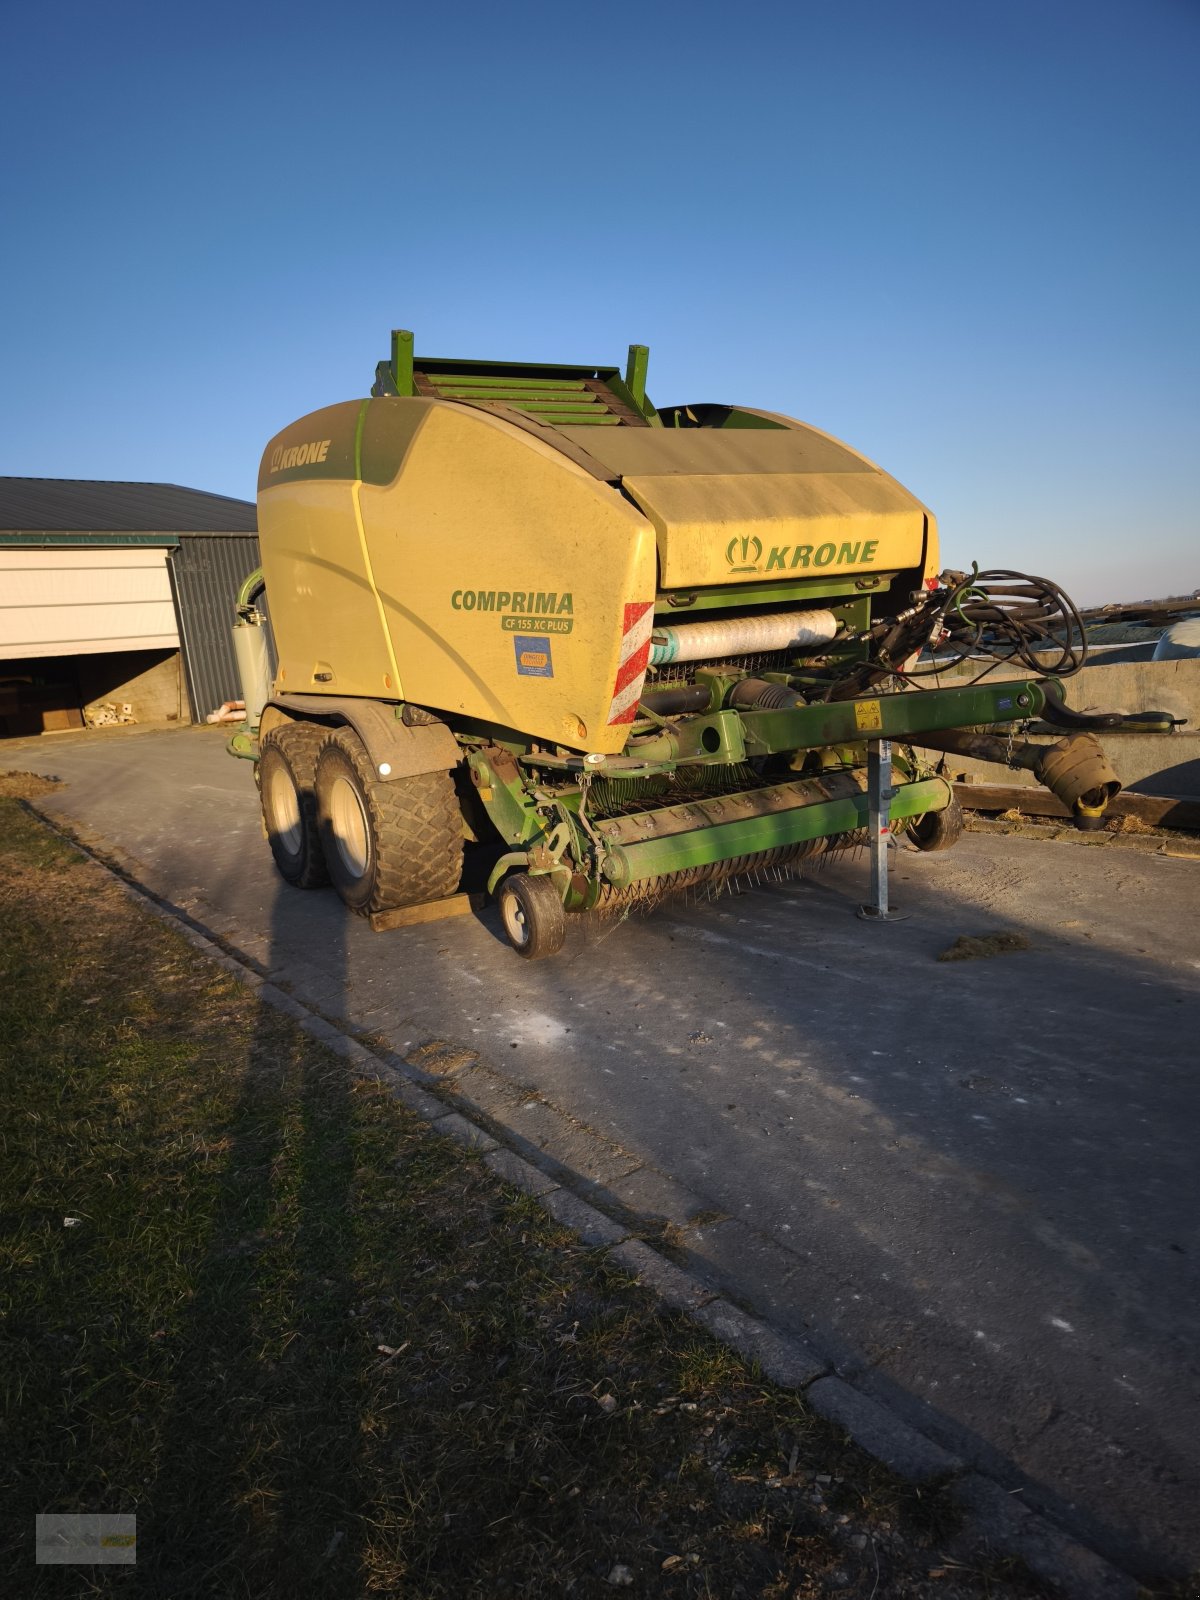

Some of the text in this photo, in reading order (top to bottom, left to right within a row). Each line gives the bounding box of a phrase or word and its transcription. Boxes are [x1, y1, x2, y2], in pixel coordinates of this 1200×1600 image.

[280, 439, 331, 471] KRONE
[765, 540, 880, 572] KRONE
[451, 589, 574, 615] COMPRIMA
[505, 618, 569, 632] CF 155 XC PLUS
